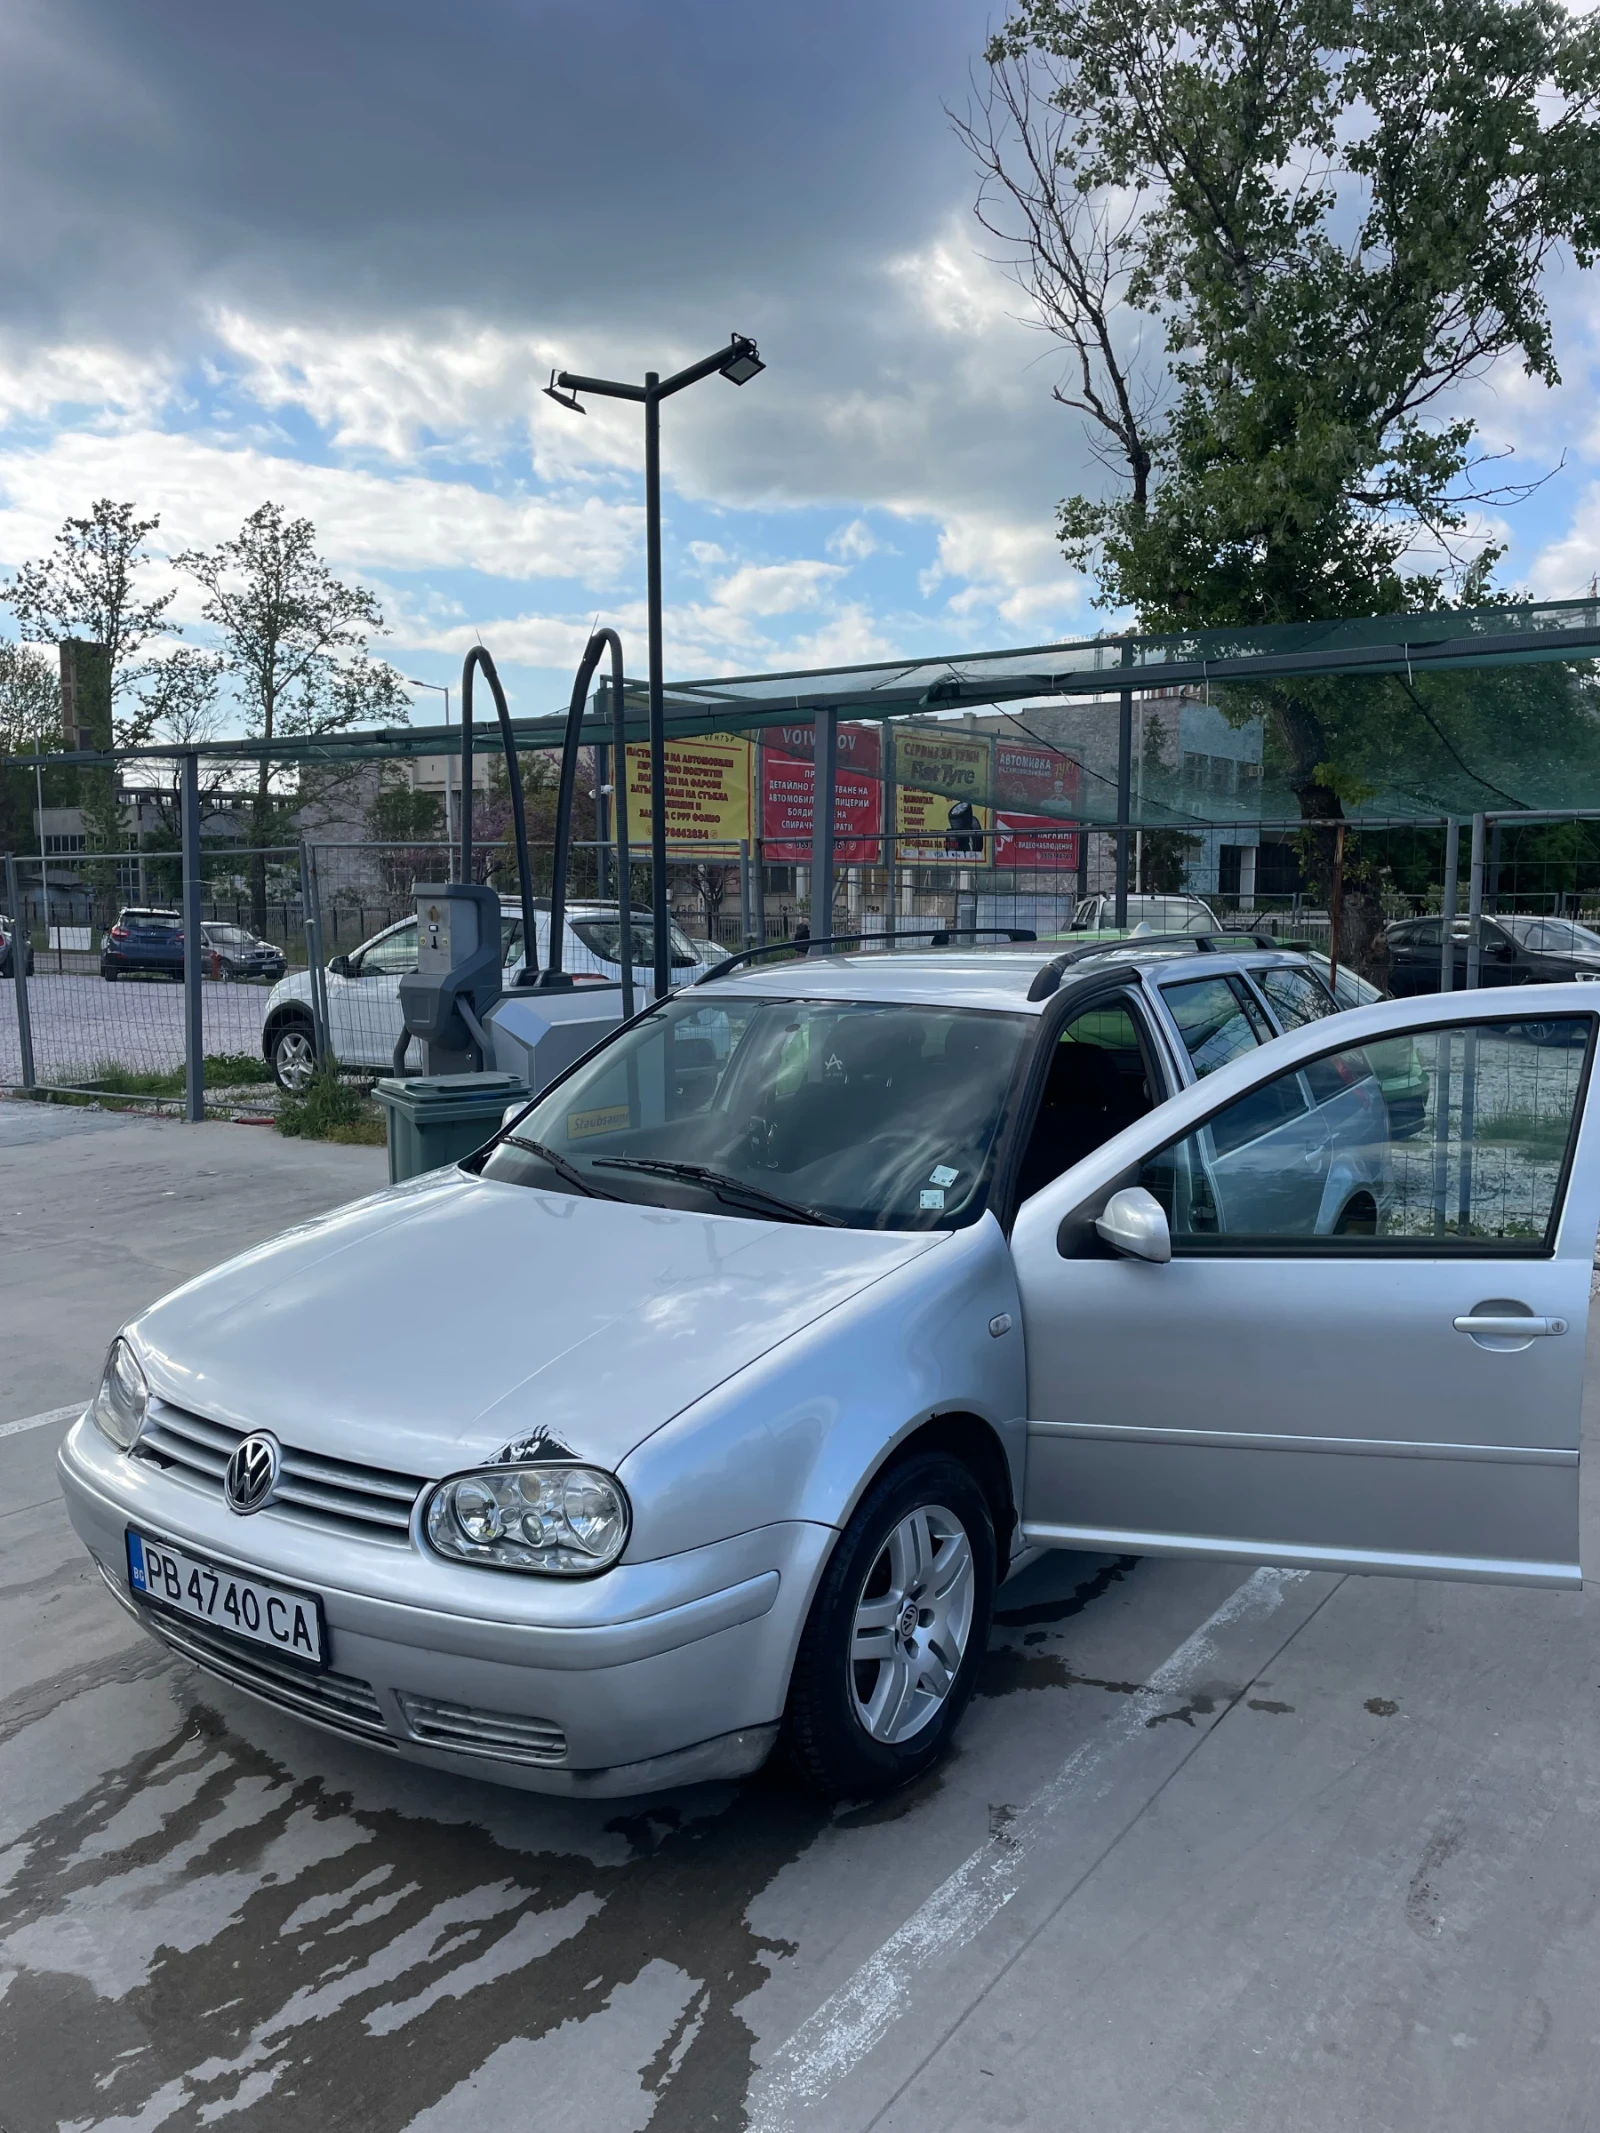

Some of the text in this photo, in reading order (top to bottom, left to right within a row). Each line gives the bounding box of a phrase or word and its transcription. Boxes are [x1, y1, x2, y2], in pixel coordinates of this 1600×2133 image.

[782, 728, 857, 750] VOIVOV
[626, 746, 734, 768] ПАСТИЕ НА АВТОМОБИЛИ
[904, 743, 939, 758] СЕРВИЗ
[1000, 753, 1051, 770] АВТОМИВКА
[638, 772, 722, 789] ПОЛАНЕ НА ФАРОВЕ
[683, 769, 723, 778] ПОКРИТИЕ
[911, 760, 976, 787] Fat Tyre
[685, 789, 697, 799] НА
[697, 790, 729, 801] СТЪКЛА
[769, 780, 868, 795] ДЕТАЙЛНО ПТВАНЕ НА
[769, 793, 870, 808] АВТОМОБИЛ ПИЦЕРИИ
[671, 812, 676, 820] С
[678, 812, 691, 821] PPF
[692, 813, 721, 823] ФОЛИО
[781, 820, 814, 829] СПИРАЧН
[1018, 841, 1074, 851] ВИДЕОНАБЛЮДЕНИЕ
[133, 1567, 145, 1582] BG
[145, 1547, 313, 1653] PB 4740 CA
